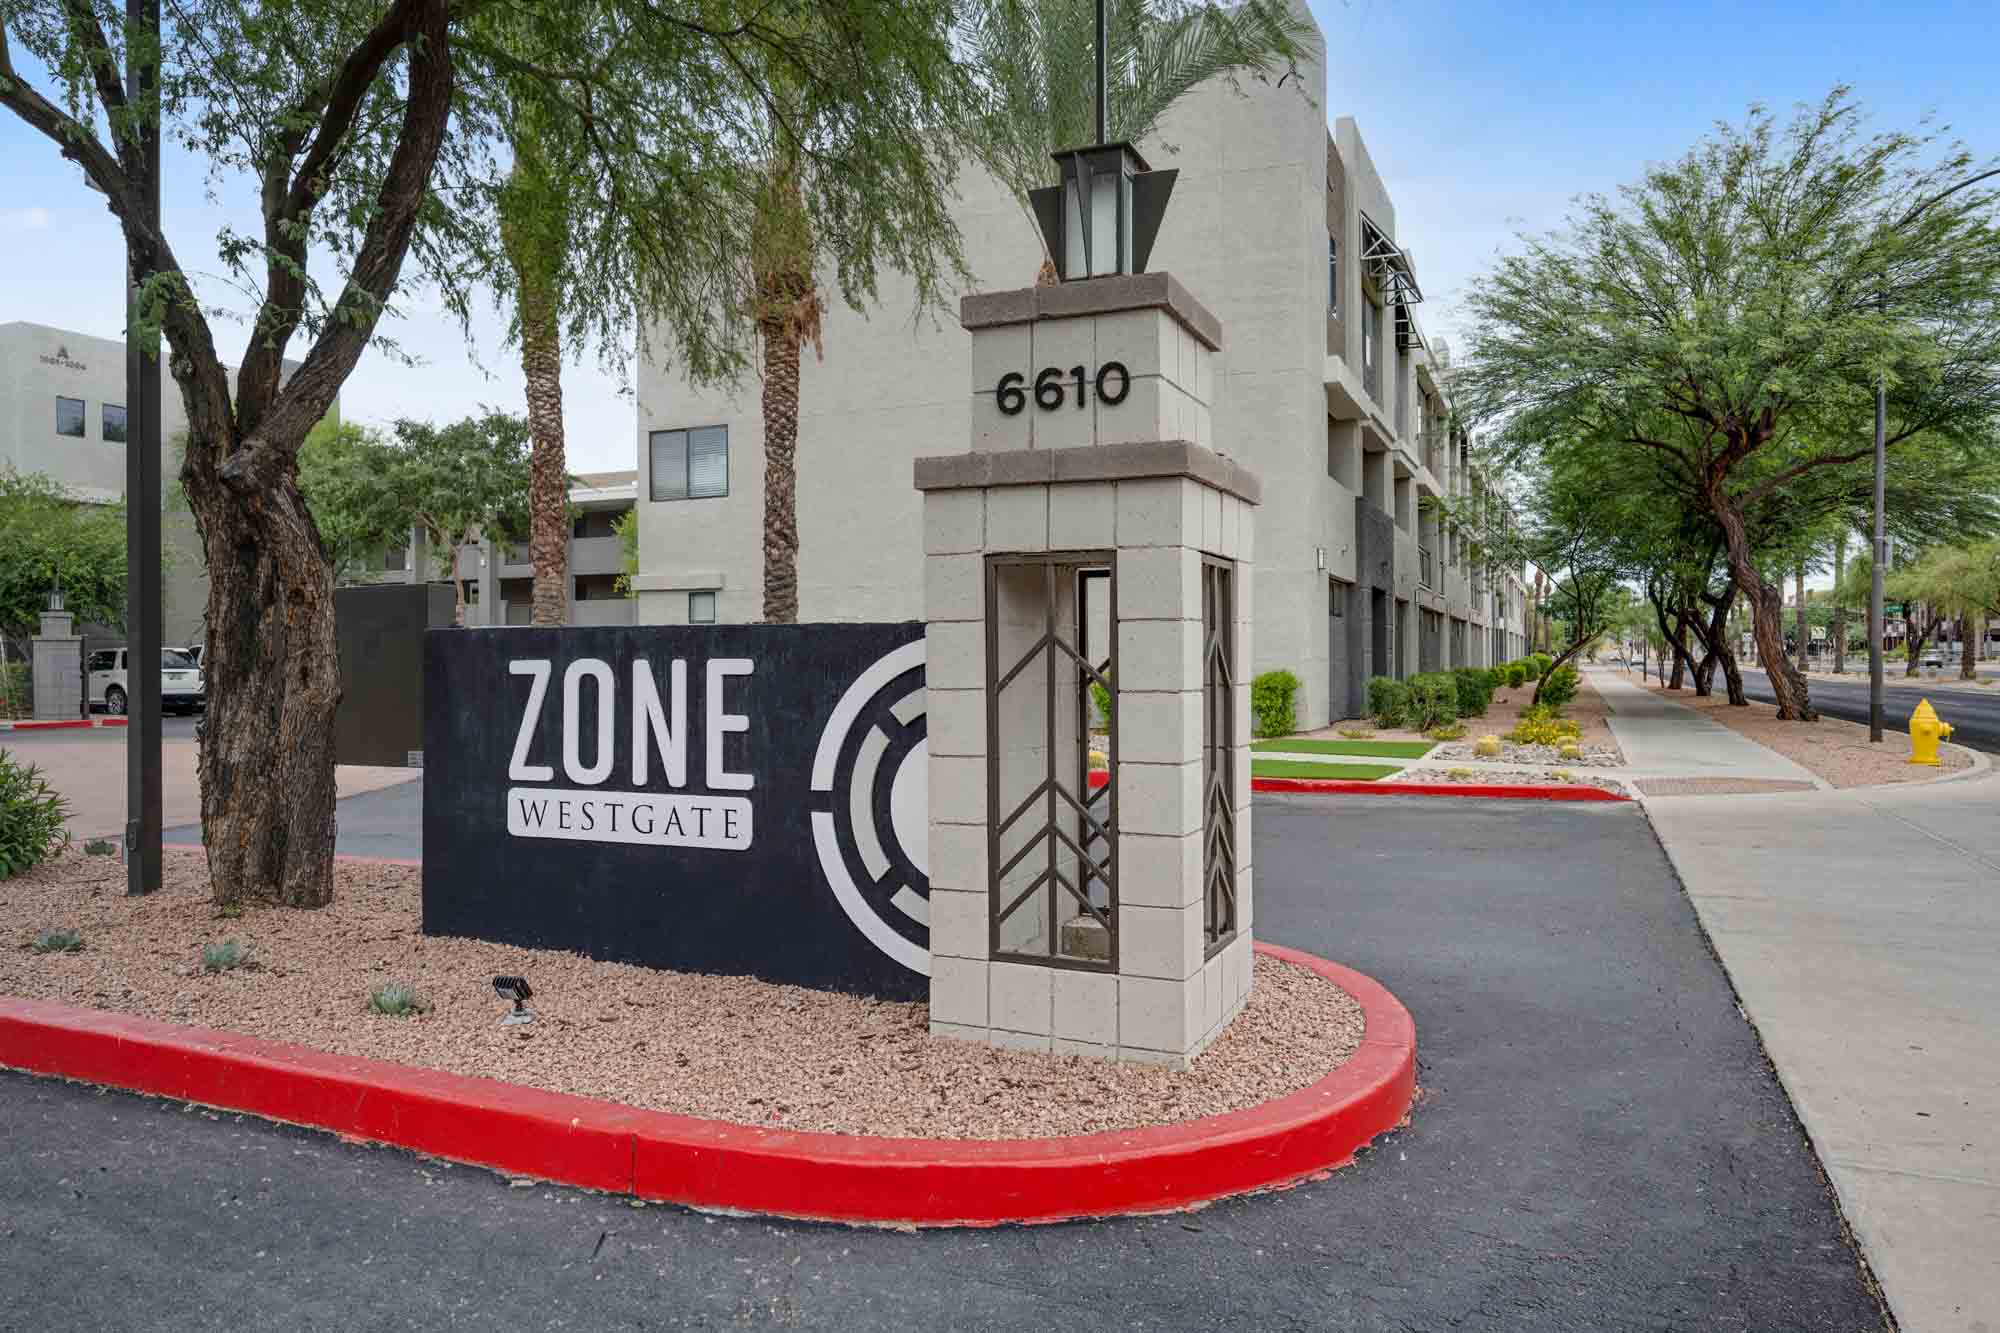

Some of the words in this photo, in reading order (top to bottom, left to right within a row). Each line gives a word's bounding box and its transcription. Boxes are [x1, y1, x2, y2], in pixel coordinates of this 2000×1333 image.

[996, 361, 1130, 415] 6610
[508, 658, 755, 791] ZONE
[519, 799, 739, 839] WESTGATE
